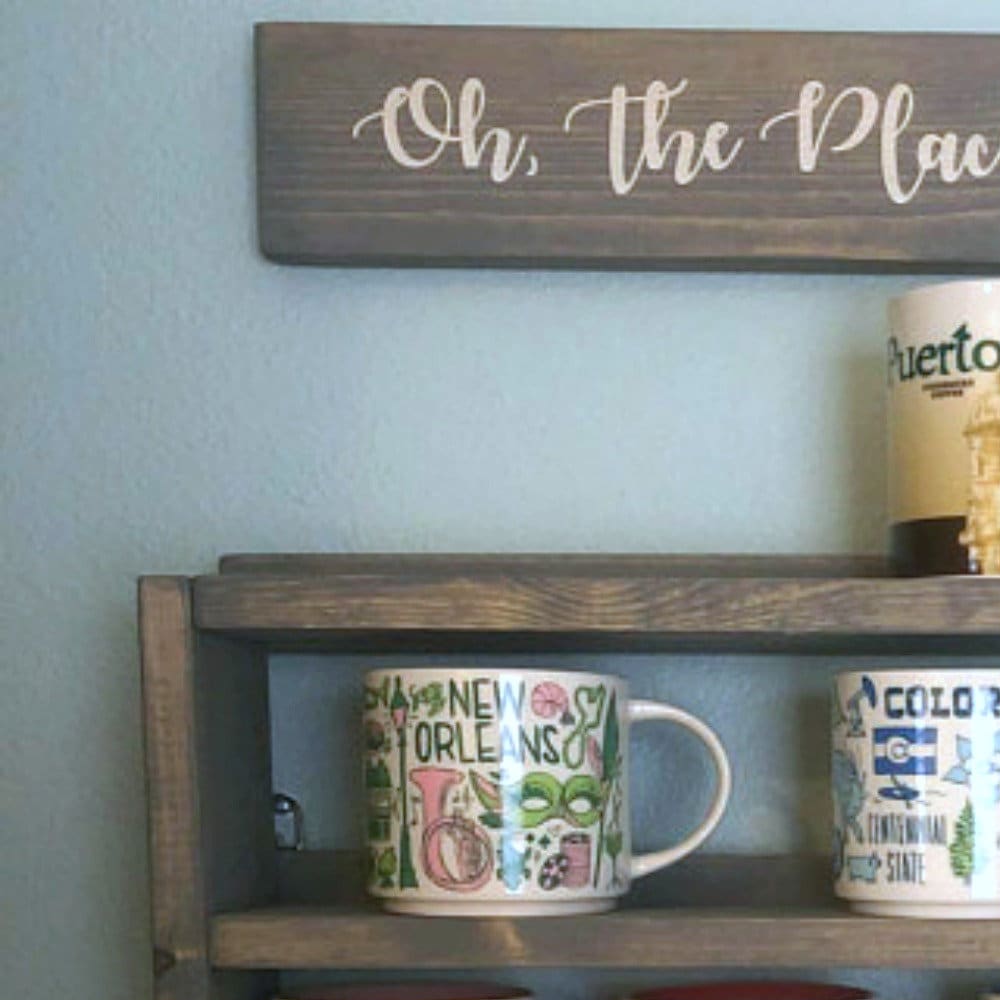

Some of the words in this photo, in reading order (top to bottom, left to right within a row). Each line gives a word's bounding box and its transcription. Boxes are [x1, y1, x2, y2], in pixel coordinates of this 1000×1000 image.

[353, 77, 539, 183] Oh,
[449, 678, 526, 720] NEW
[413, 721, 561, 764] ORLEANS
[886, 851, 925, 885] STATE
